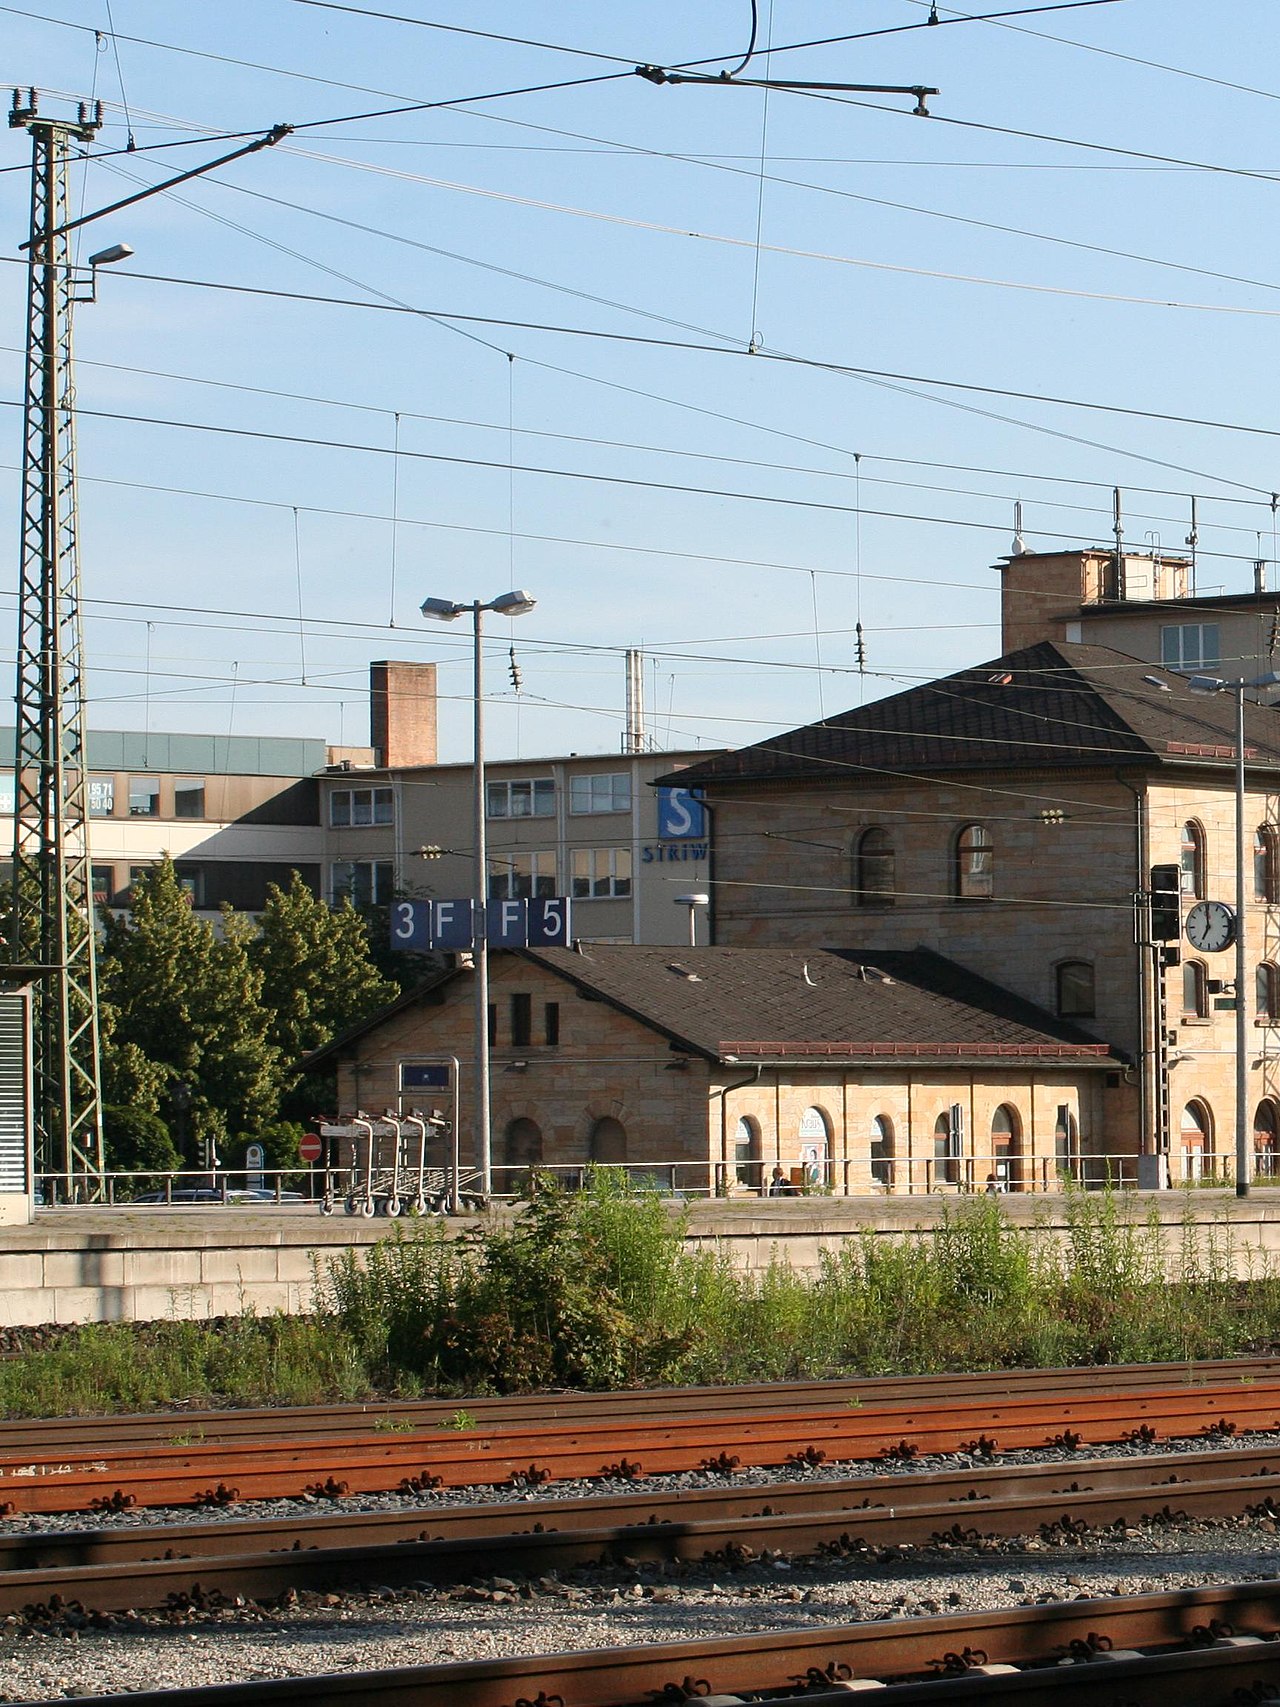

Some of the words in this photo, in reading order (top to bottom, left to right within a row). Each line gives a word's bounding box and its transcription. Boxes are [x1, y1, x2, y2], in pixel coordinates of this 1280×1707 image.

[395, 902, 414, 938] 3
[436, 902, 454, 938] F
[501, 901, 519, 936] F
[543, 900, 561, 936] 5
